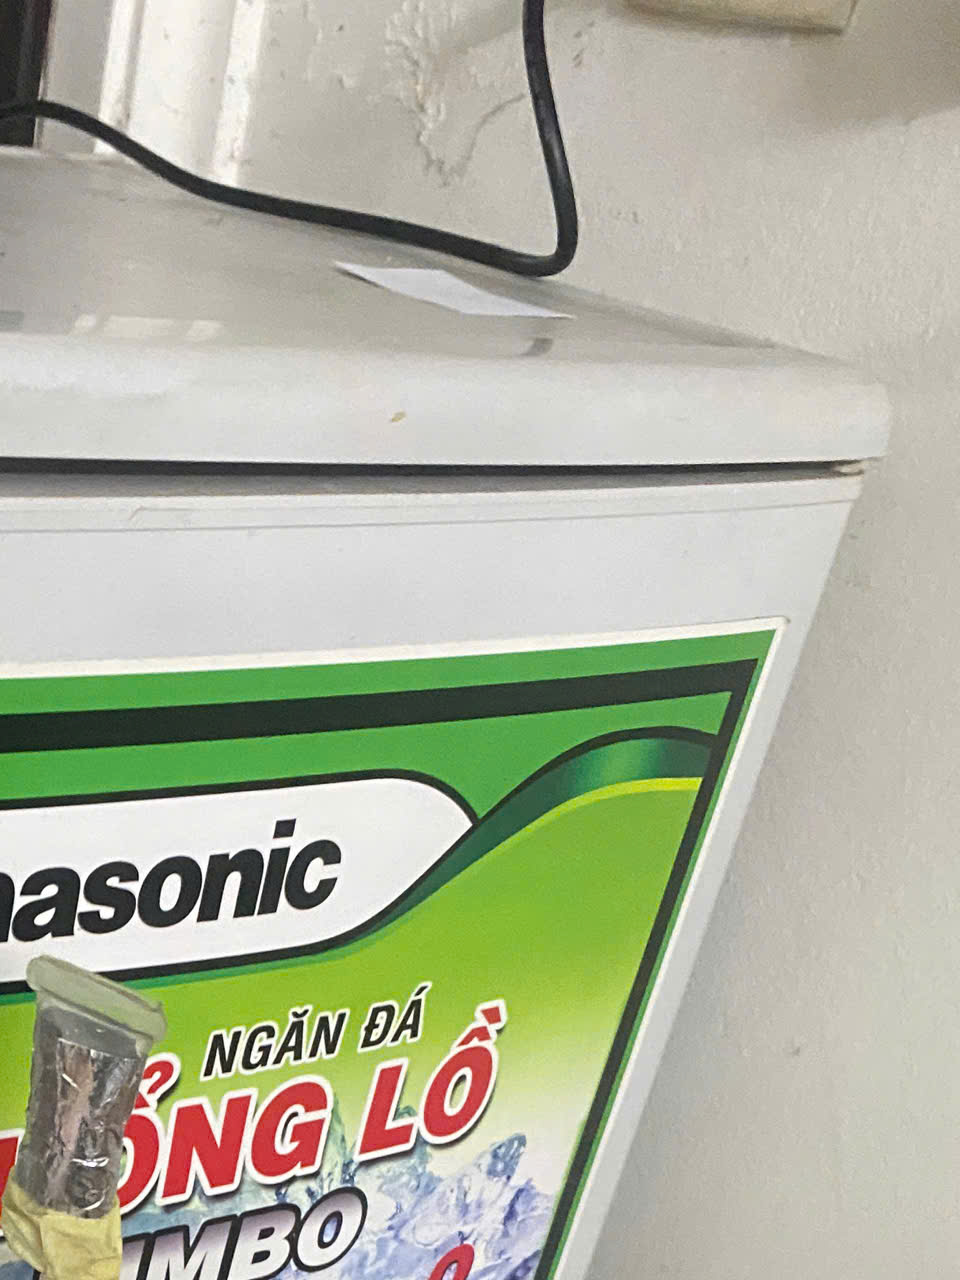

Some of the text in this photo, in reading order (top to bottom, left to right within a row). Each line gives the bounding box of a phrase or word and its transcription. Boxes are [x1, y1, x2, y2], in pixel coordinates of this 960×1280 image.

[203, 985, 429, 1077] NGĂN ĐÁ
[358, 1004, 502, 1158] LỒ
